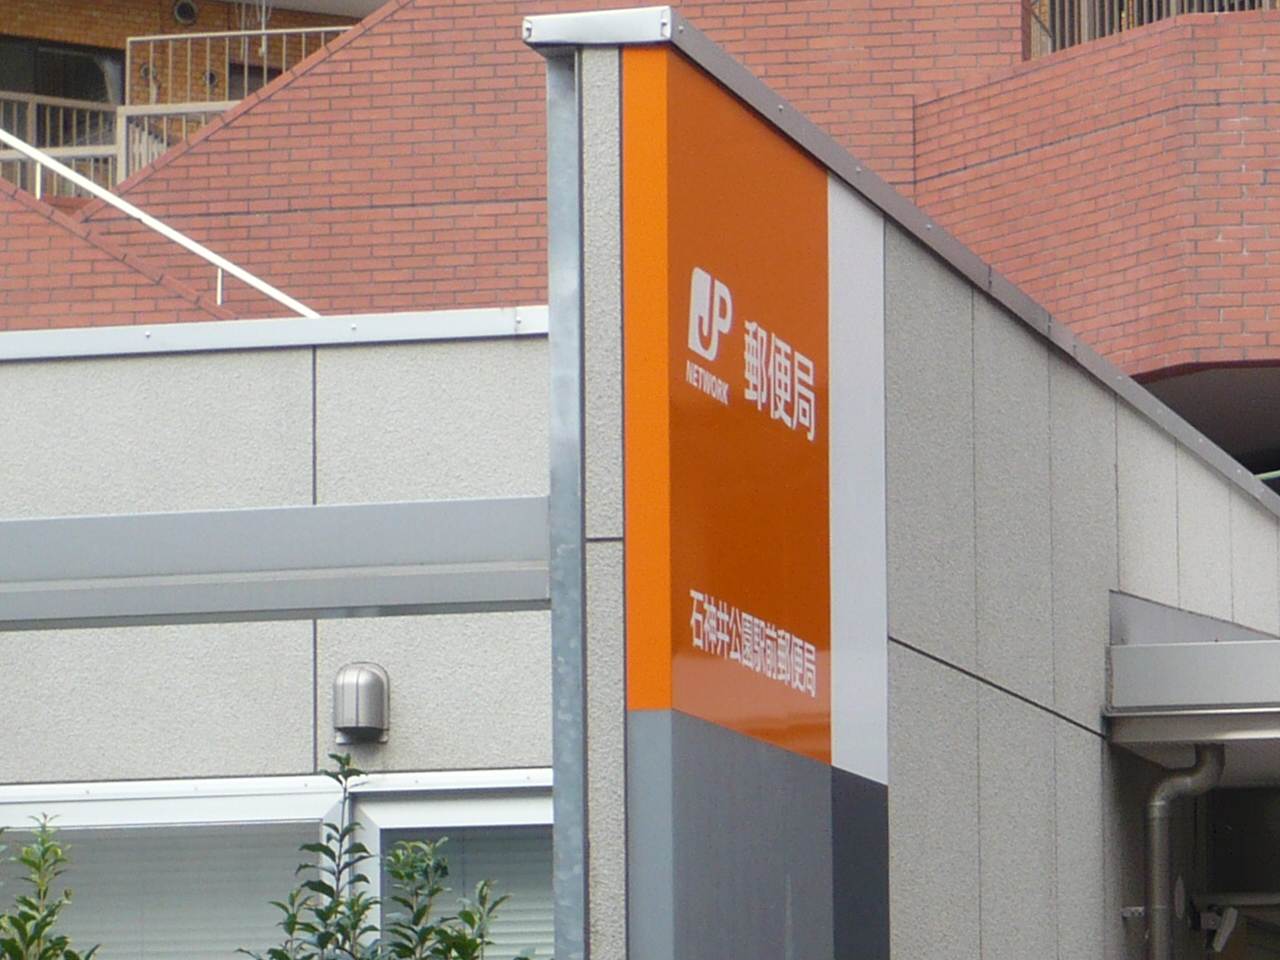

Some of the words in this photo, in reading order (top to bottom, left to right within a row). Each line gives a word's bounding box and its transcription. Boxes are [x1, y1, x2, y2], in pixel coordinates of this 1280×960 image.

[685, 359, 730, 406] NETWORK
[687, 267, 733, 361] JP
[743, 320, 816, 441] 郵便局
[690, 589, 817, 698] 石神井公園駅前郵便局
